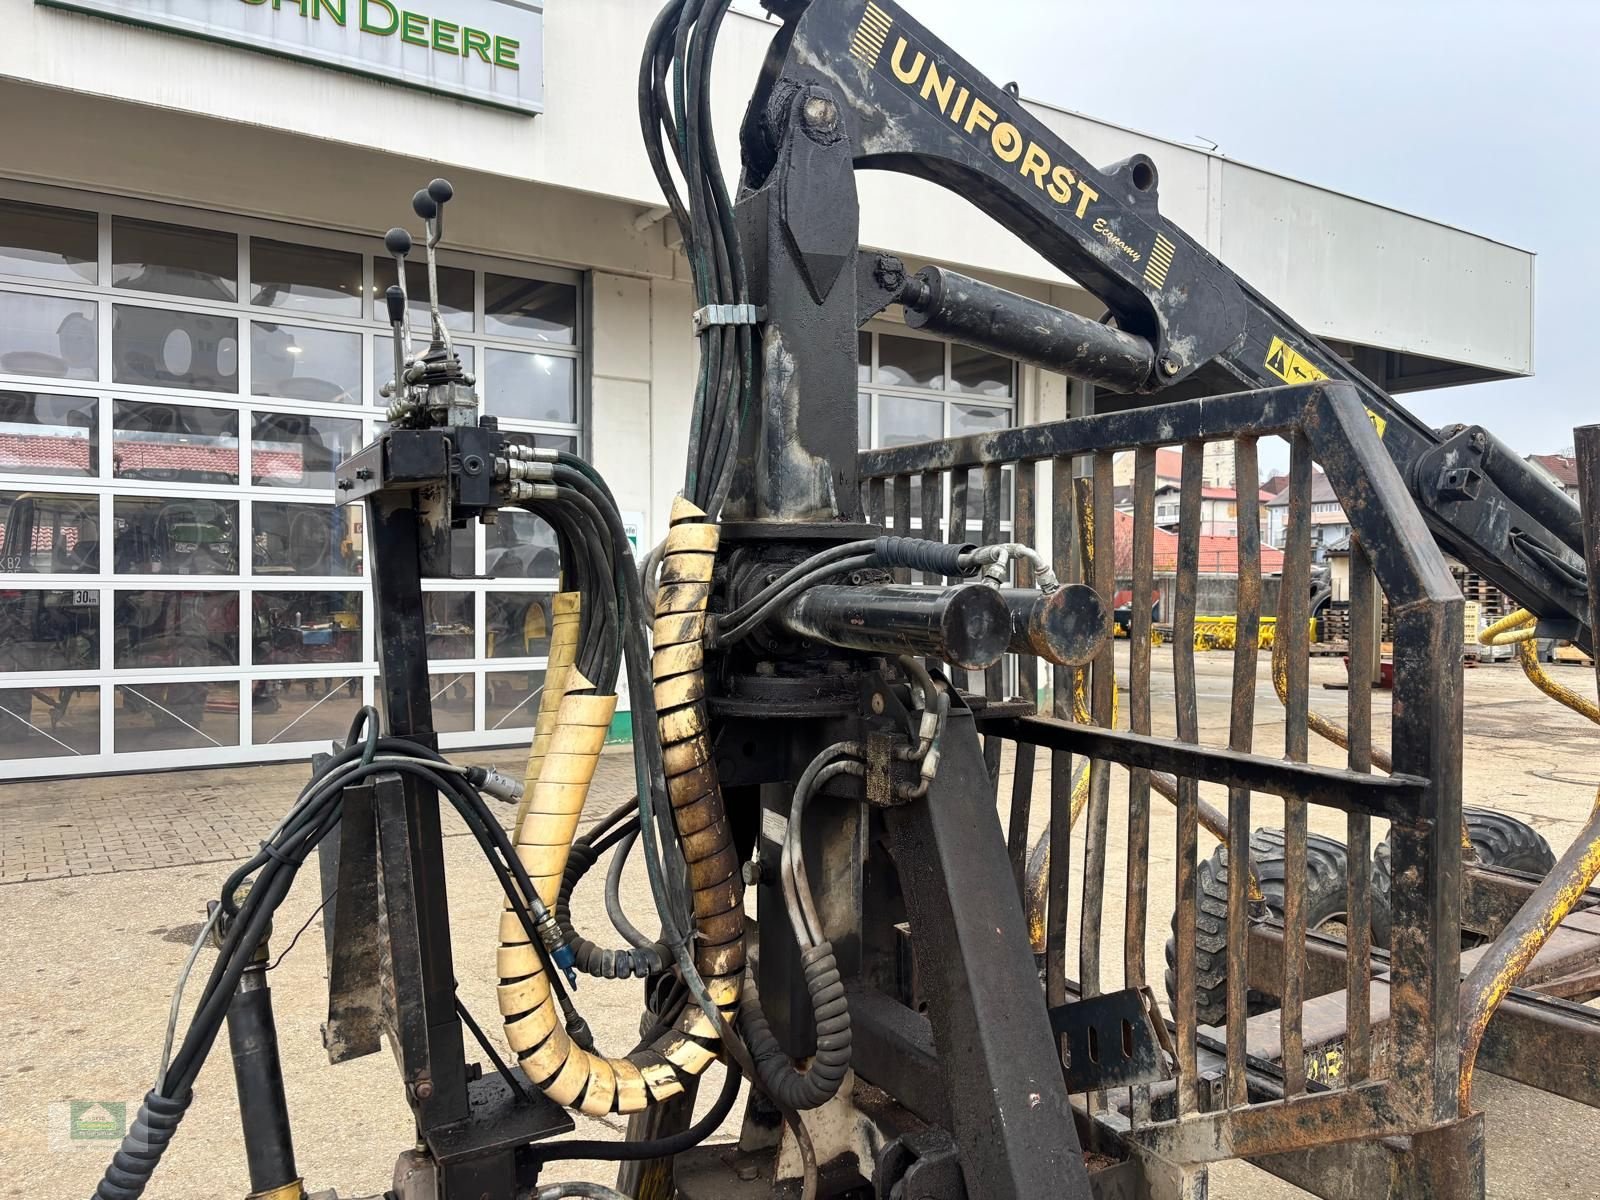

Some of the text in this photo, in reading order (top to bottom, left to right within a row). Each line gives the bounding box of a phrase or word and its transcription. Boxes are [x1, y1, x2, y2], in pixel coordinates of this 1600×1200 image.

[359, 0, 520, 70] DEERE
[890, 36, 1099, 220] UNIFORST
[1092, 217, 1141, 262] Economy
